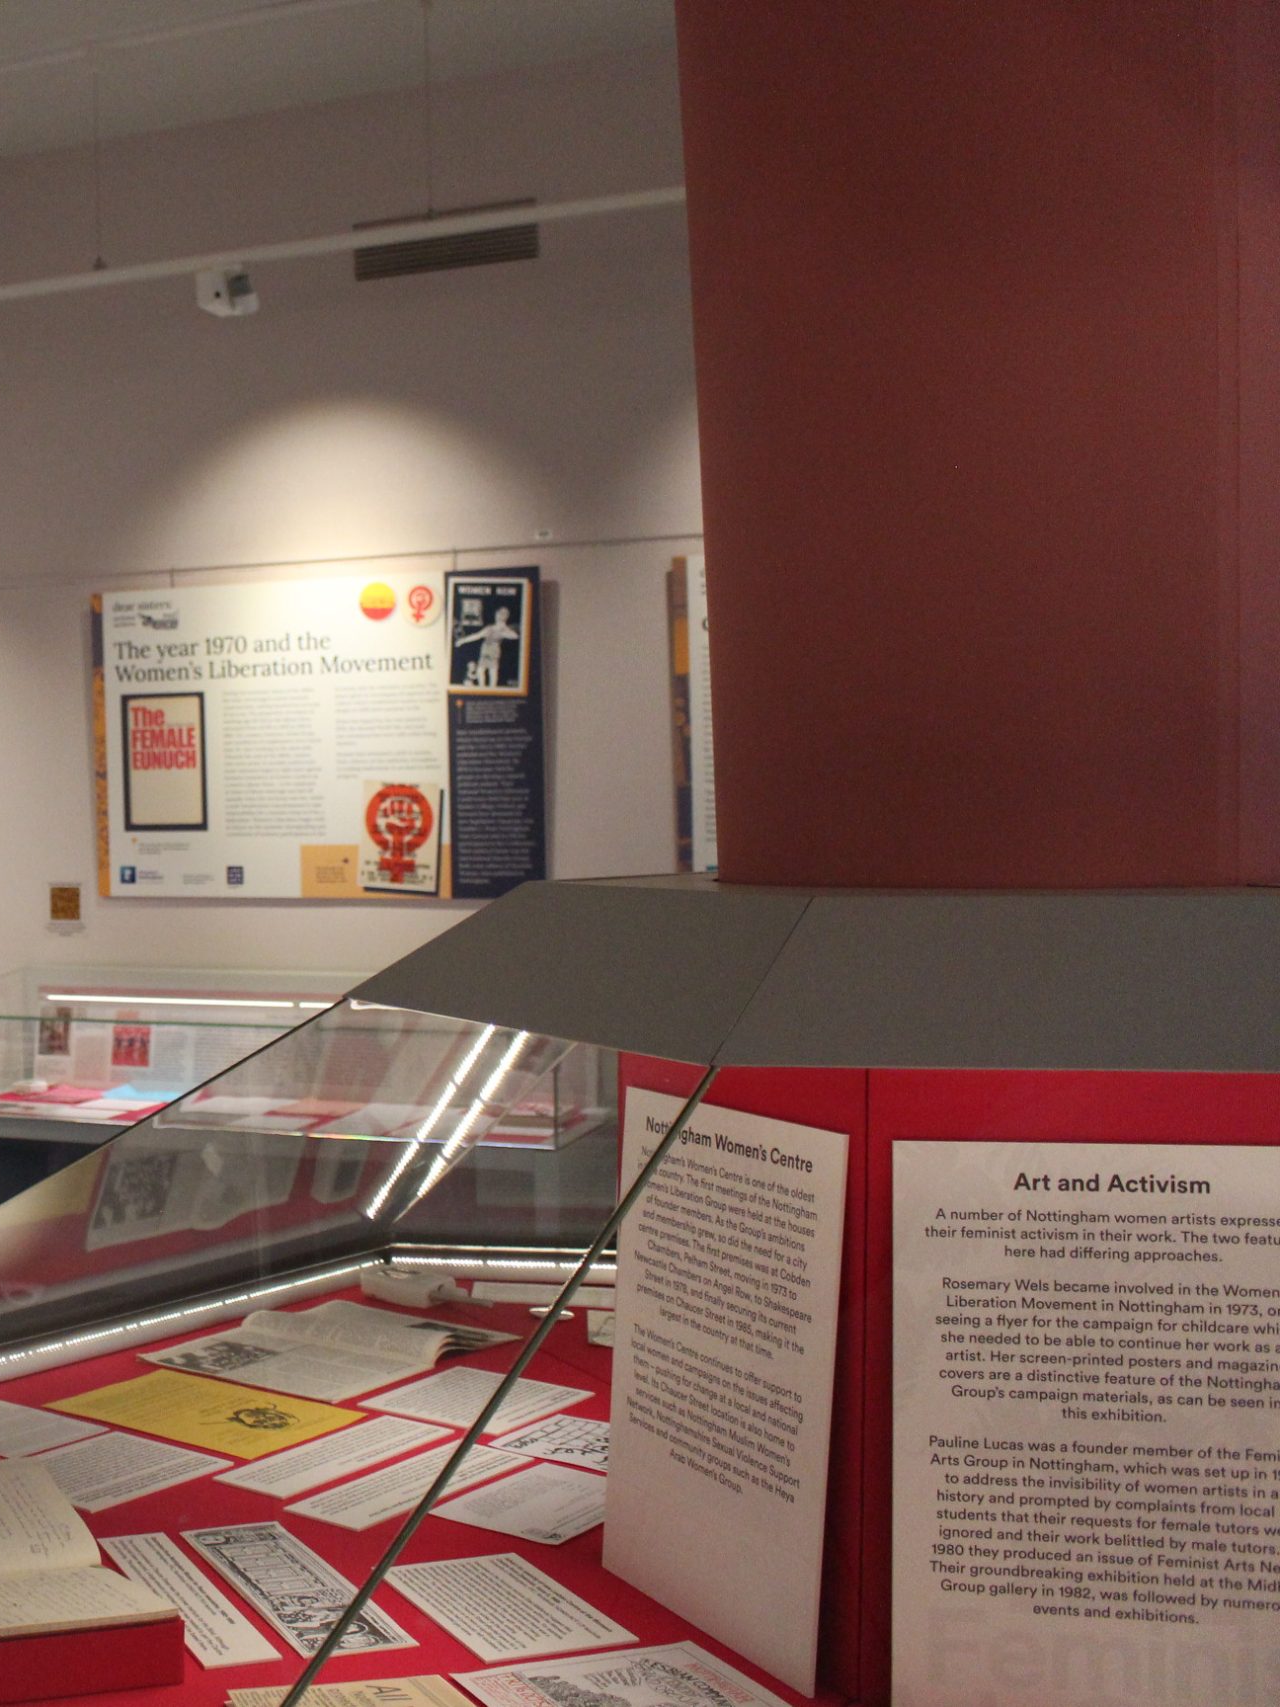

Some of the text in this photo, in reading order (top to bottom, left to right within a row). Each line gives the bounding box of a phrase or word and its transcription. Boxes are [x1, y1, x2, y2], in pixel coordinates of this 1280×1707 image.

[114, 632, 331, 664] The year 1970 and the
[116, 653, 434, 684] Women's Liberation Movement
[131, 706, 165, 727] The
[131, 727, 196, 750] FEMALE
[131, 749, 197, 770] EUNUCH
[715, 1133, 767, 1161] Women's
[770, 1148, 813, 1173] Centre
[1013, 1172, 1210, 1194] Art and Activism
[935, 1207, 946, 1219] A
[950, 1208, 1004, 1221] number
[1007, 1209, 1022, 1221] of
[1026, 1209, 1110, 1225] Nottingham
[1113, 1214, 1166, 1224] women
[1170, 1213, 1216, 1225] artists
[924, 1225, 957, 1238] their
[960, 1226, 1016, 1239] feminist
[1020, 1228, 1078, 1240] activism
[1082, 1231, 1095, 1240] in
[1099, 1229, 1132, 1242] their
[1135, 1230, 1176, 1242] work.
[1180, 1230, 1208, 1244] The
[1211, 1232, 1240, 1244] two
[1004, 1244, 1222, 1263] here had differing approaches.
[942, 1277, 1010, 1293] Rosemary
[1014, 1279, 1049, 1292] Wels
[1053, 1280, 1110, 1293] became
[1114, 1282, 1174, 1295] involved
[1178, 1286, 1190, 1295] in
[1194, 1283, 1219, 1297] the
[946, 1295, 1016, 1309] Liberation
[1021, 1297, 1097, 1311] Movement
[1101, 1302, 1114, 1311] in
[1118, 1300, 1204, 1316] Nottingham
[1208, 1305, 1222, 1314] in
[1225, 1303, 1262, 1318] 1973,
[935, 1315, 980, 1328] seeing
[984, 1316, 992, 1326] a
[996, 1314, 1028, 1329] flyer
[1031, 1315, 1052, 1328] for
[1055, 1316, 1078, 1328] the
[1082, 1319, 1153, 1333] campaign
[1156, 1319, 1177, 1331] for
[1181, 1320, 1249, 1334] childcare
[940, 1331, 964, 1343] she
[968, 1332, 1021, 1345] needed
[1024, 1333, 1039, 1345] to
[1043, 1334, 1061, 1346] be
[1064, 1335, 1096, 1347] able
[1098, 1335, 1114, 1348] to
[1117, 1337, 1181, 1350] continue
[1185, 1338, 1209, 1351] her
[1212, 1340, 1250, 1352] work
[1254, 1343, 1270, 1353] as
[944, 1350, 985, 1361] artist.
[990, 1350, 1016, 1363] Her
[1018, 1353, 1123, 1367] screen-printed
[1128, 1356, 1181, 1369] posters
[1185, 1357, 1212, 1369] and
[938, 1368, 984, 1380] covers
[988, 1370, 1011, 1381] are
[1014, 1371, 1023, 1381] a
[1026, 1370, 1100, 1383] distinctive
[1103, 1372, 1156, 1385] feature
[1159, 1374, 1174, 1386] of
[1178, 1374, 1202, 1387] the
